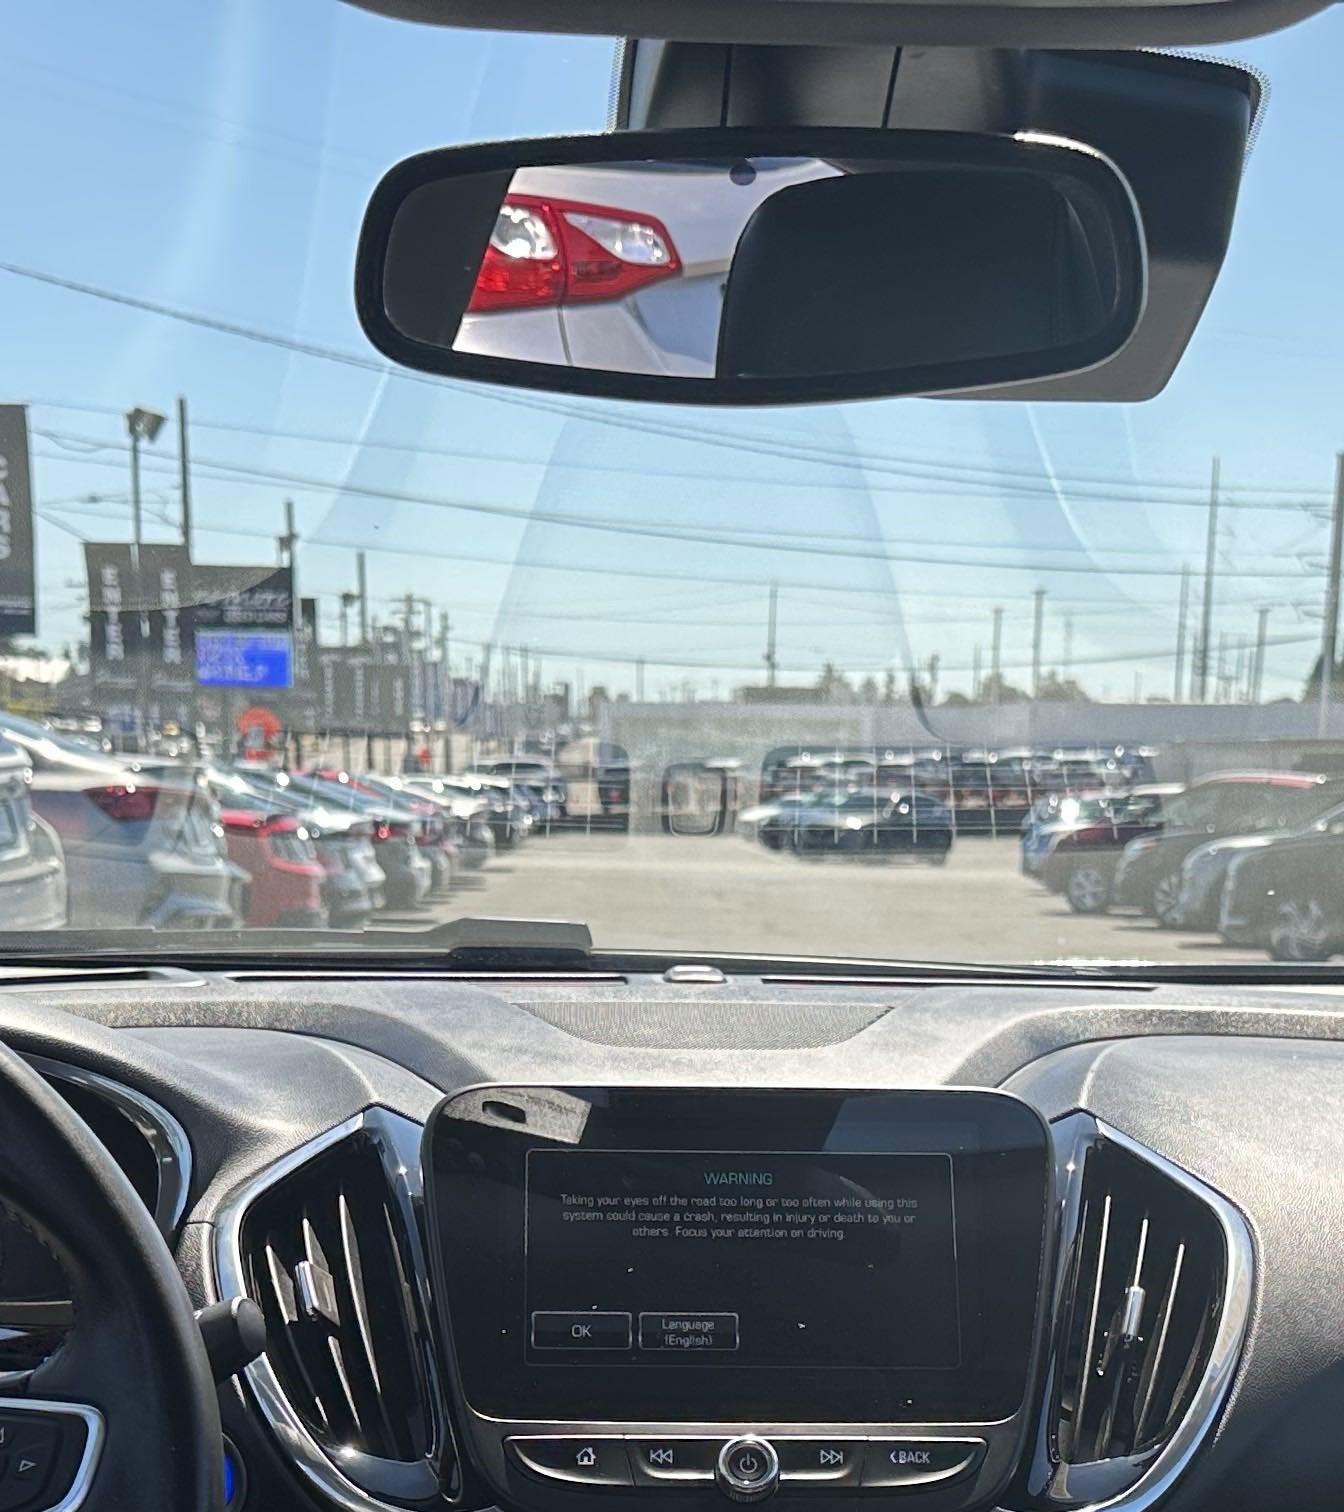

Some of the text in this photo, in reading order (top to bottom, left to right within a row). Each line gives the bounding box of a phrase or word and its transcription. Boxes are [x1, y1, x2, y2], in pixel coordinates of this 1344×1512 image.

[101, 565, 125, 660] ENTER
[159, 567, 182, 664] ENTER
[704, 1172, 773, 1186] WARNING
[560, 1194, 918, 1210] Taking your eyes off the road too long or too often while using this
[562, 1211, 604, 1222] system
[606, 1210, 636, 1221] could
[638, 1212, 670, 1222] cause
[673, 1213, 680, 1222] a
[720, 1211, 770, 1224] resulting
[773, 1213, 782, 1222] in
[785, 1212, 815, 1225] injury
[818, 1214, 831, 1223] or
[833, 1212, 865, 1223] death
[867, 1214, 879, 1224] to
[882, 1215, 901, 1225] you
[903, 1215, 914, 1224] or
[675, 1226, 708, 1238] Focus
[711, 1228, 734, 1239] your
[738, 1228, 788, 1238] attention
[790, 1229, 804, 1238] on
[571, 1324, 592, 1338] OK
[661, 1319, 715, 1332] Language
[664, 1334, 713, 1348] (English)
[898, 1450, 931, 1464] BACK
